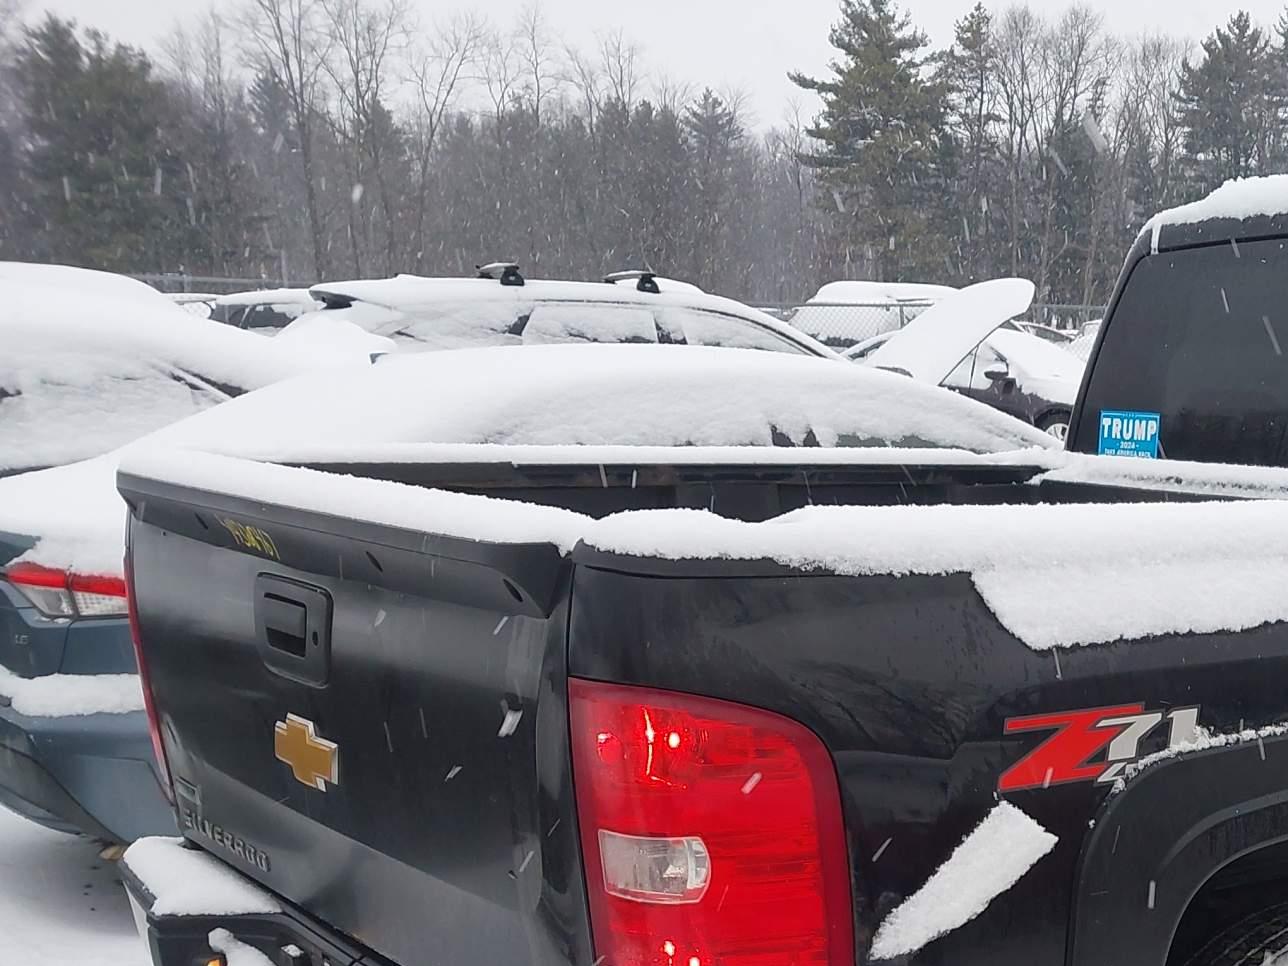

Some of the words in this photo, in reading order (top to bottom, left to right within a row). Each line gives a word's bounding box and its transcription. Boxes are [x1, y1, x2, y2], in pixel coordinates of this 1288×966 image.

[1102, 417, 1157, 441] TRUMP
[998, 701, 1200, 791] Z71
[183, 807, 271, 873] SILVERADO
